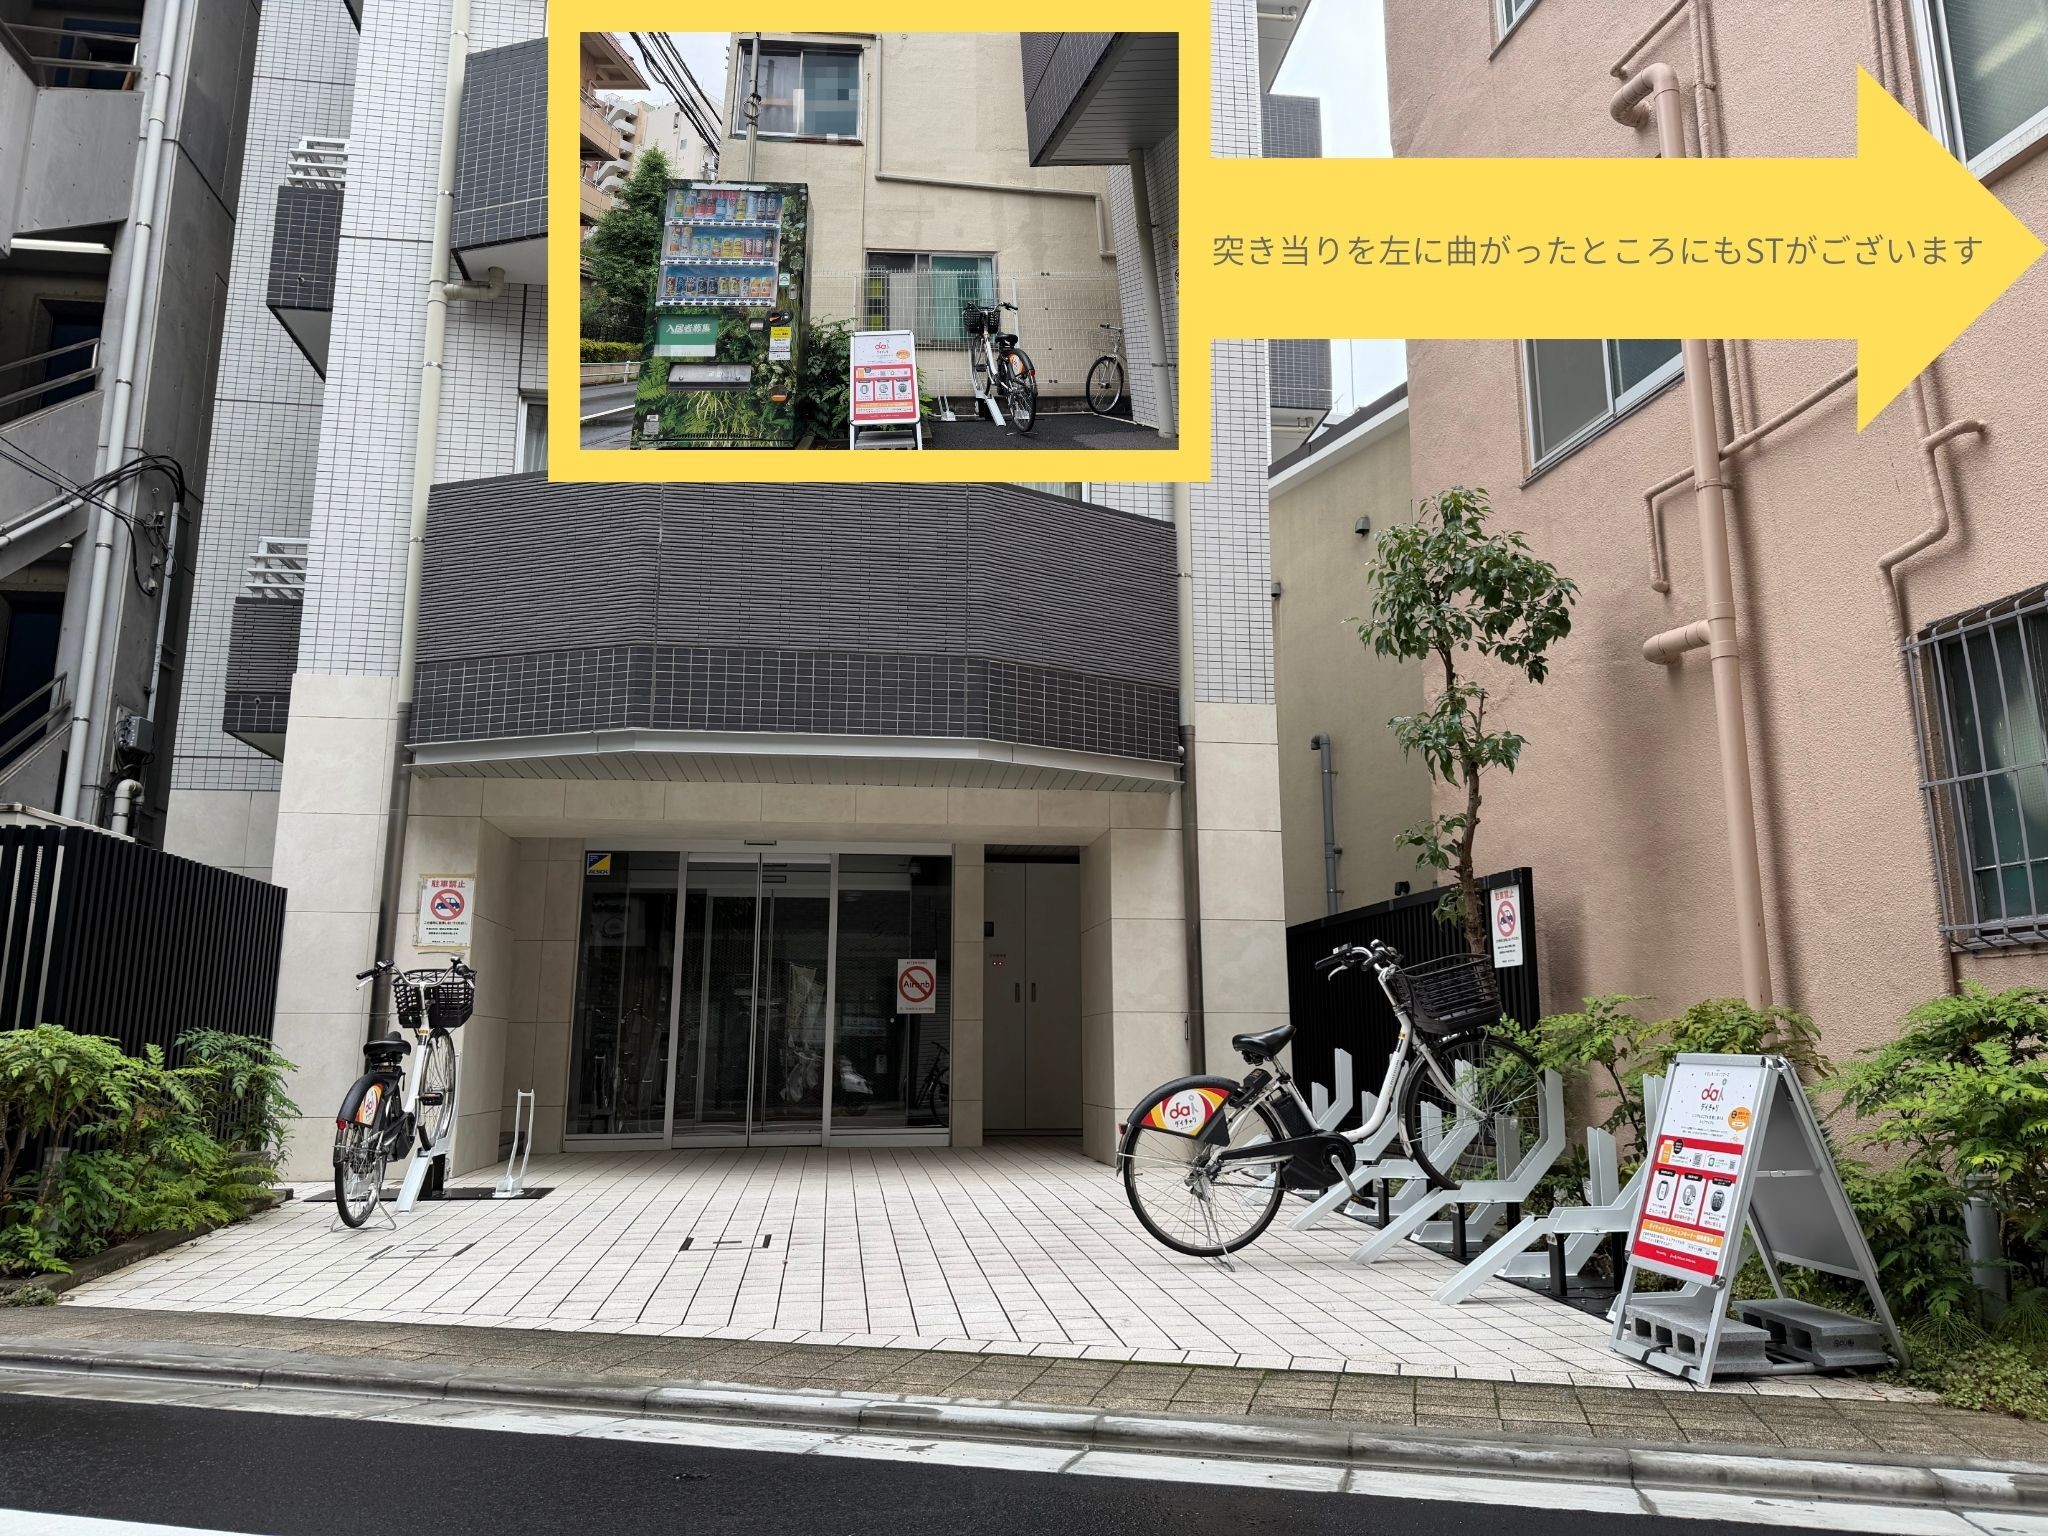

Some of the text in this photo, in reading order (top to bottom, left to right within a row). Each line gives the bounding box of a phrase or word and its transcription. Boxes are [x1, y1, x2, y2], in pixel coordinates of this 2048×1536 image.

[666, 323, 711, 333] 入居者募集
[431, 879, 466, 889] 駐車禁止
[1174, 1117, 1197, 1127] ダイチャリ
